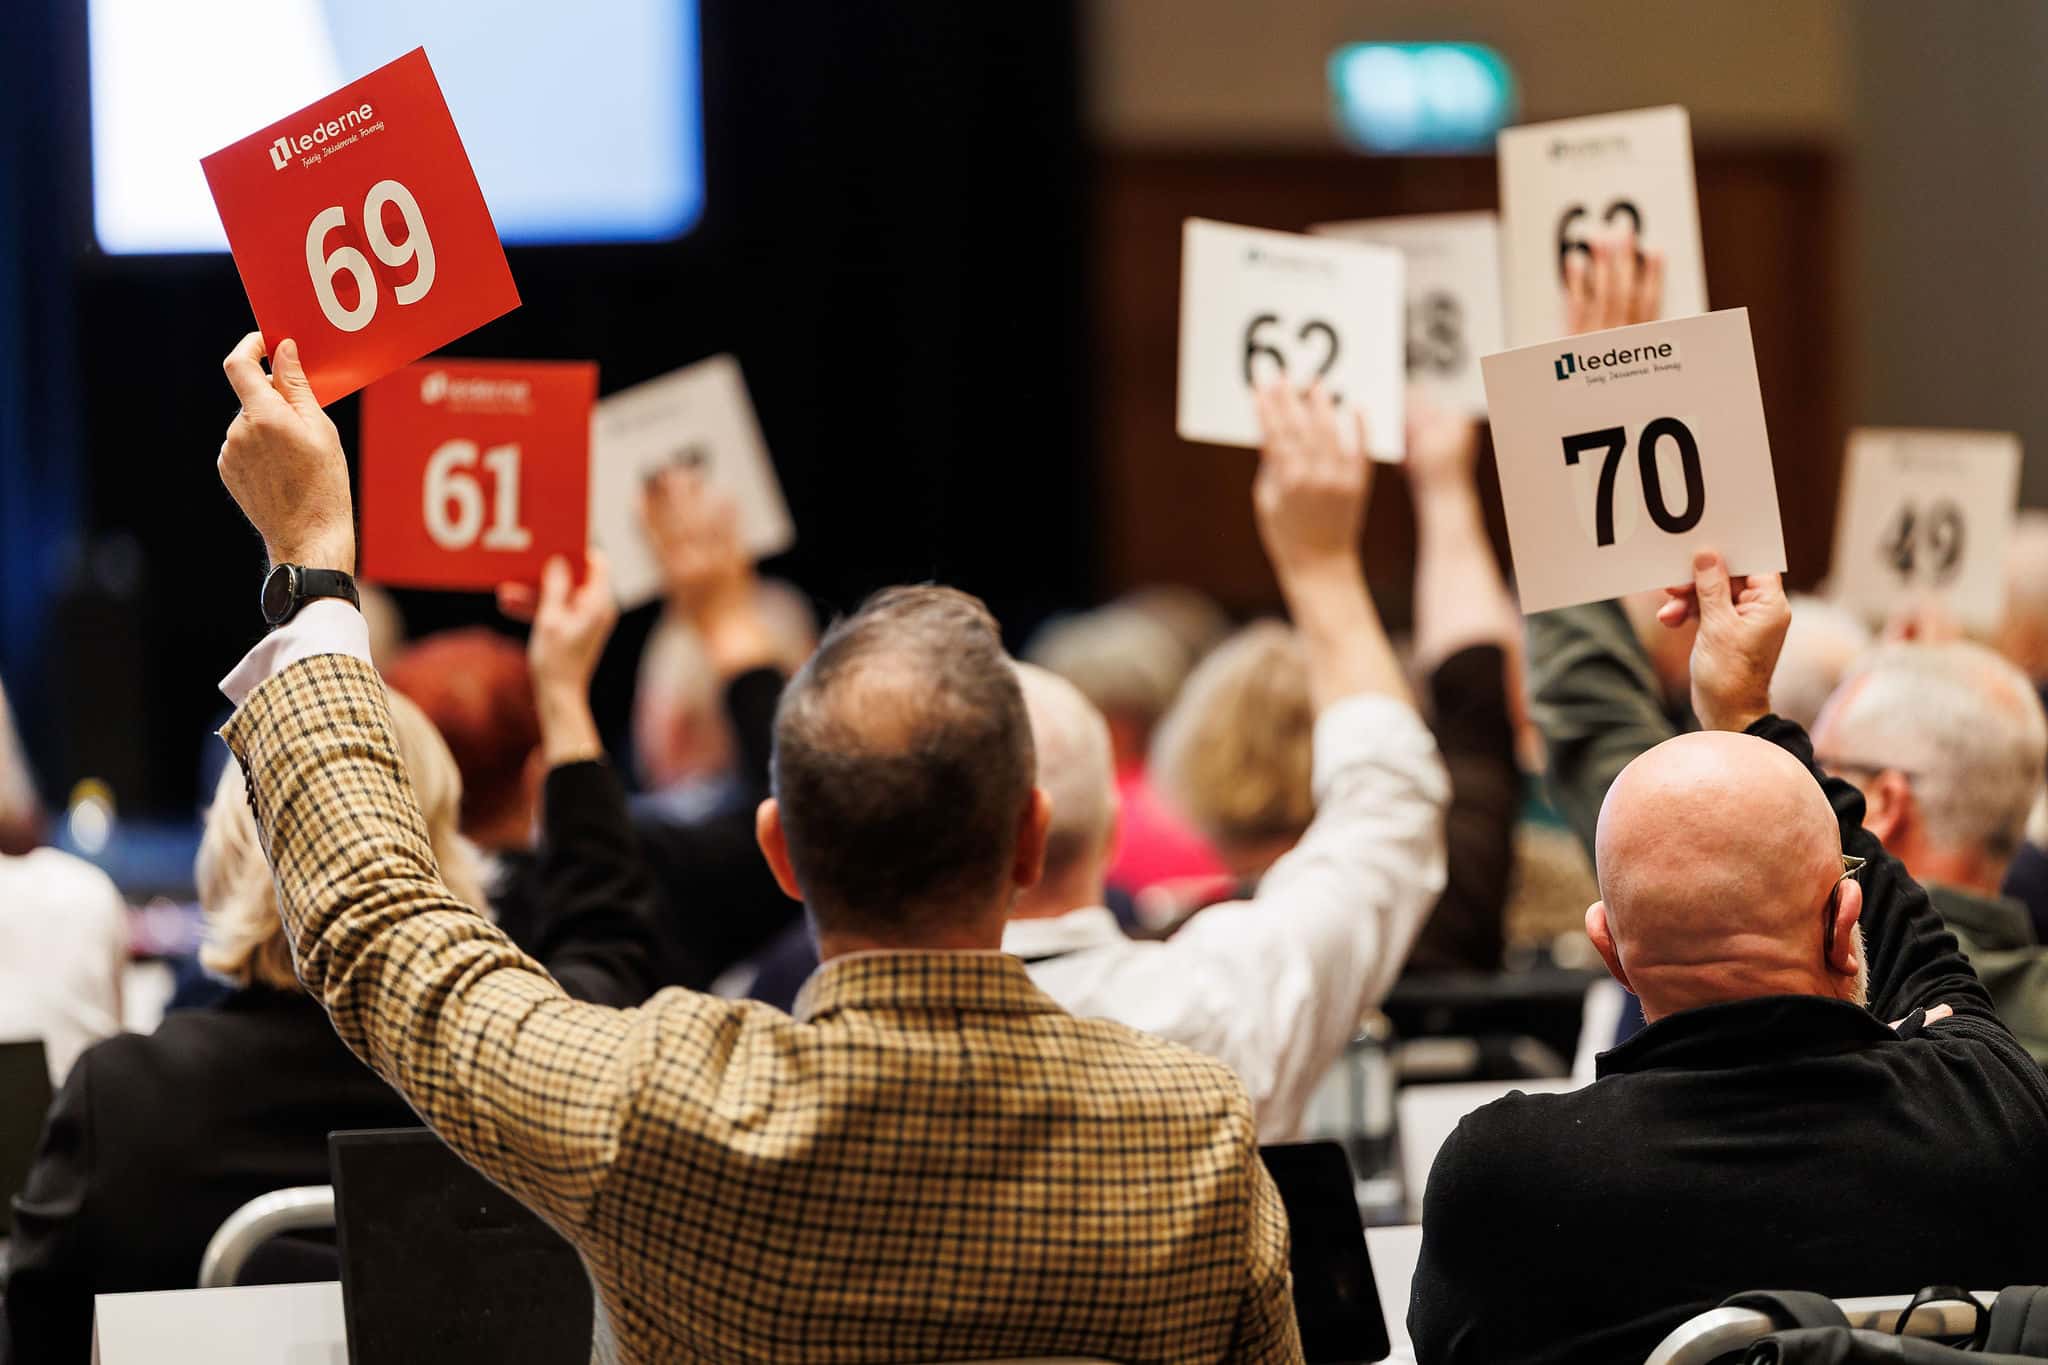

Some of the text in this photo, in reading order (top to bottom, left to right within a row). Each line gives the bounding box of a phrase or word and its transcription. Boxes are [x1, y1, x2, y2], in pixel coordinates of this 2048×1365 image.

[290, 103, 373, 154] lederne
[305, 179, 436, 332] 69
[1578, 342, 1673, 371] lederne
[422, 438, 533, 551] 61
[1561, 416, 1705, 547] 70
[1876, 499, 1966, 587] 49
